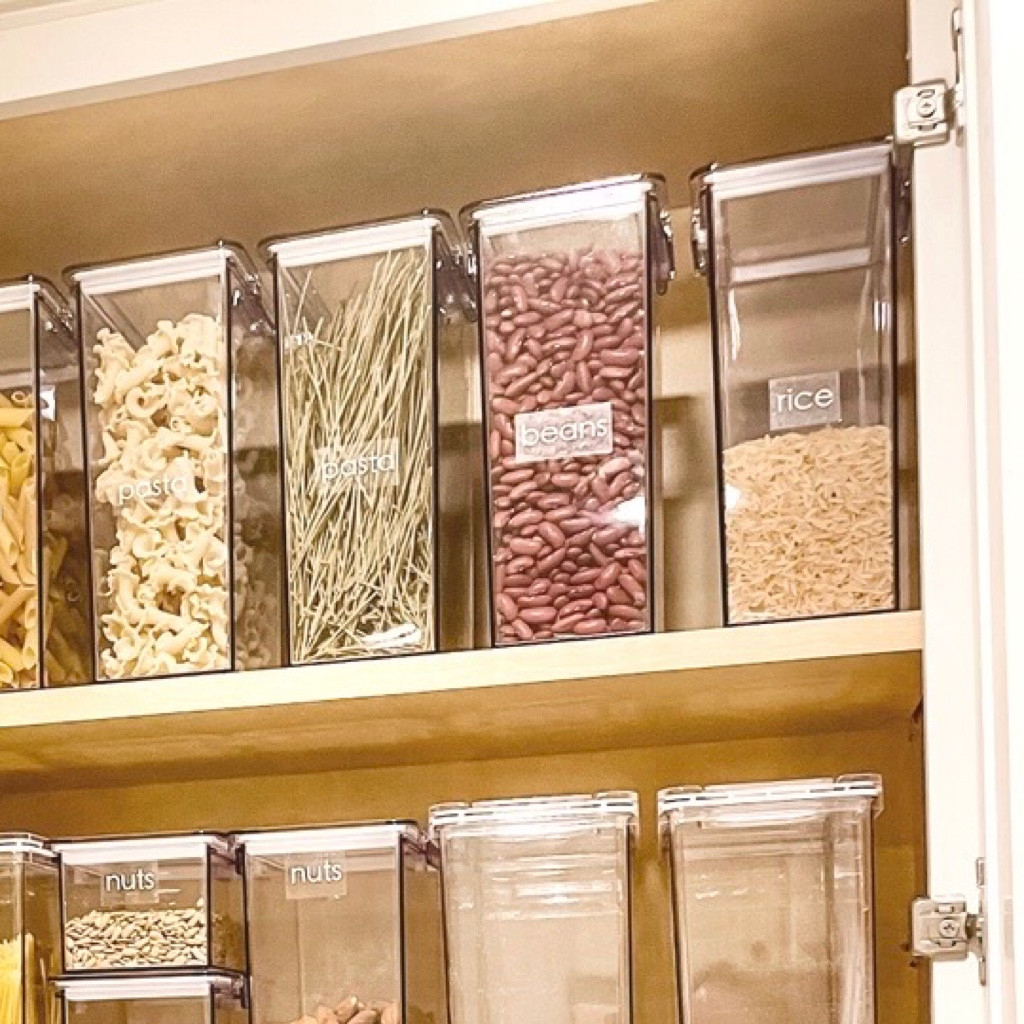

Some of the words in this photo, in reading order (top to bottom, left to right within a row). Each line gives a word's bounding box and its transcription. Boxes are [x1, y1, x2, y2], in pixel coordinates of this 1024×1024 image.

[776, 386, 834, 412] rice
[520, 414, 609, 446] beans
[322, 454, 395, 483] pasta
[118, 475, 189, 504] pasta
[105, 869, 155, 891] nuts
[291, 860, 343, 885] nuts
